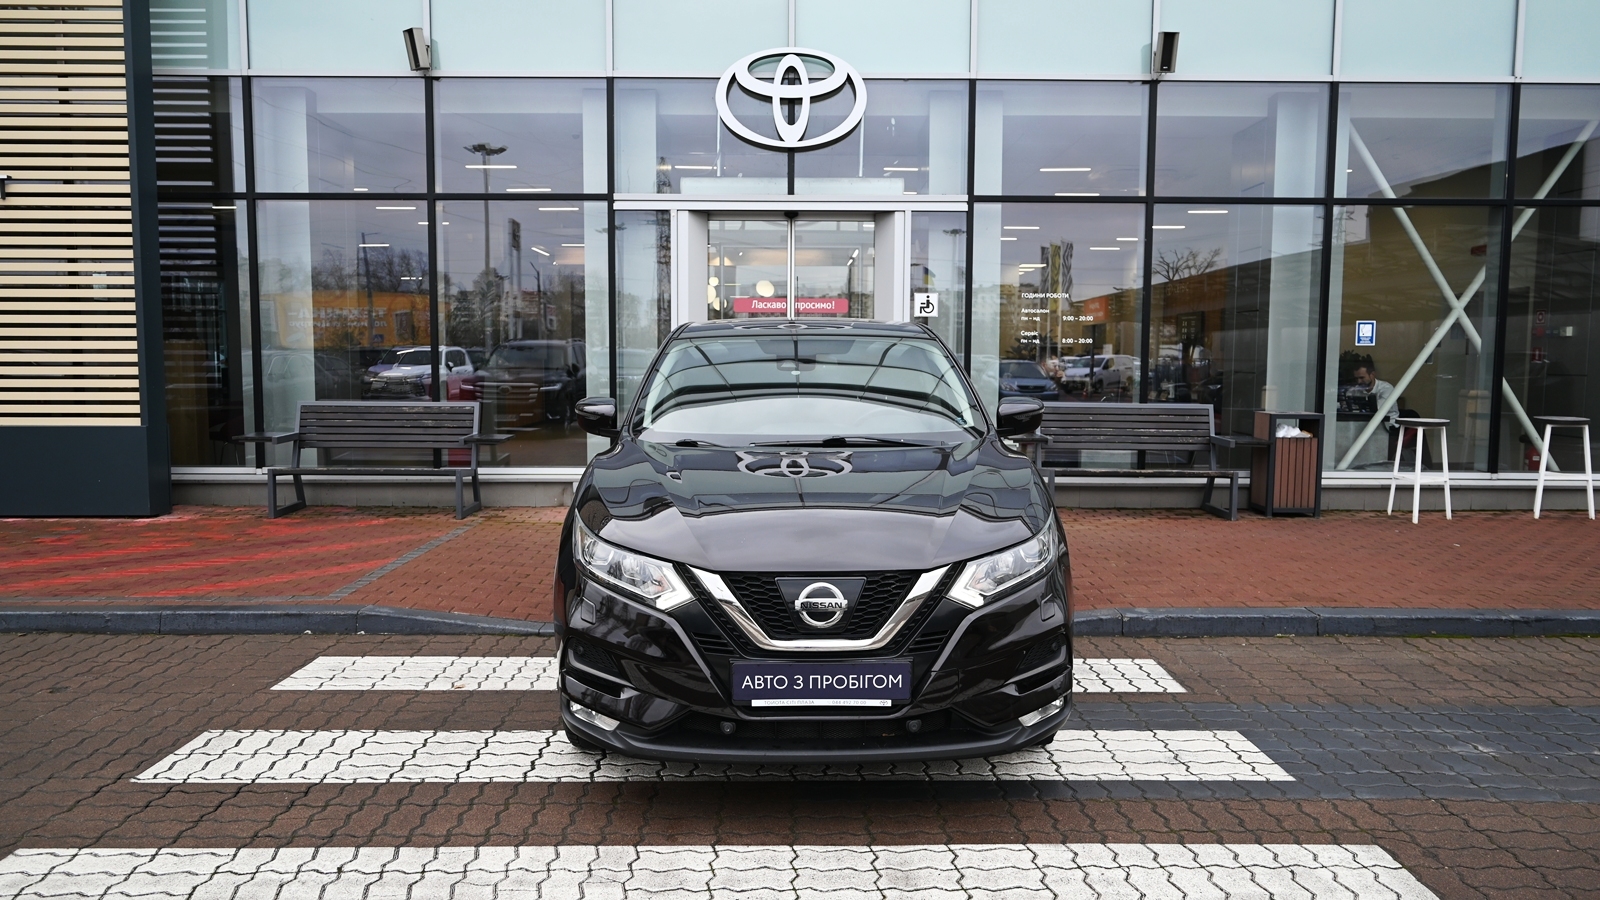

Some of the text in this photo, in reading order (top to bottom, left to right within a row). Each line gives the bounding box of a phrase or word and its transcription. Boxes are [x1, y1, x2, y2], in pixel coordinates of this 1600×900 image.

[751, 300, 835, 310] Ласкаво просимо!
[800, 601, 843, 609] NISSAN
[741, 674, 902, 690] АВТО З ПРОБІГОМ
